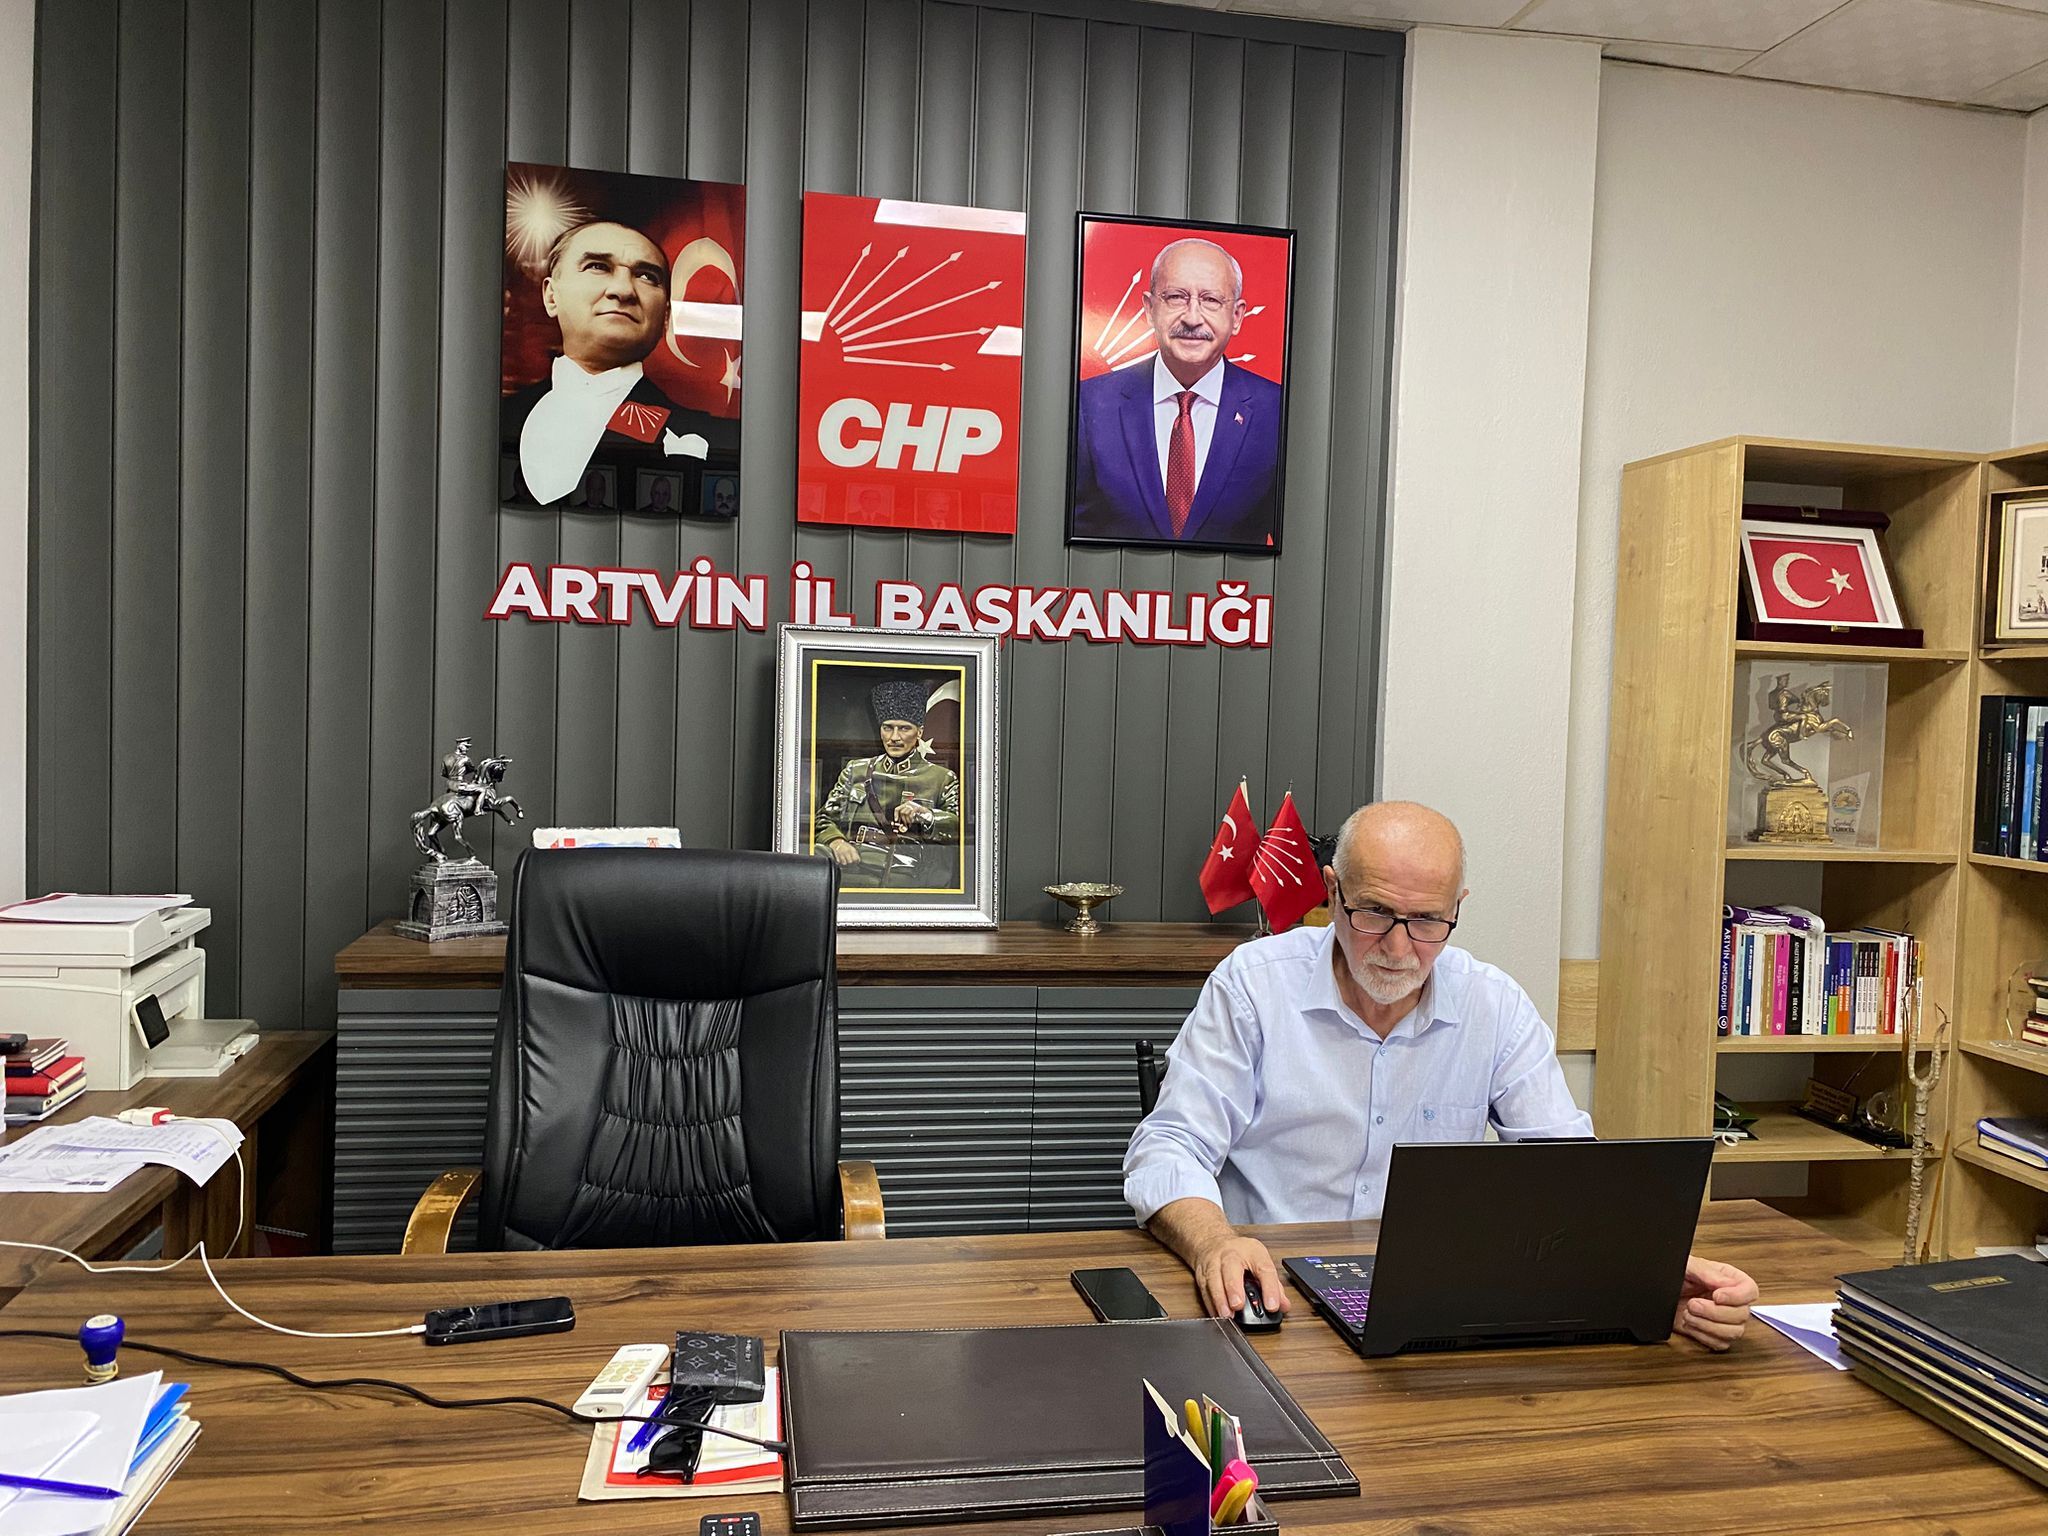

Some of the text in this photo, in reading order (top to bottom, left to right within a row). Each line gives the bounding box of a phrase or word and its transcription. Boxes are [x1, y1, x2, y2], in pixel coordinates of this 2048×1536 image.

[818, 397, 1003, 474] CHP
[483, 555, 768, 631] ARTVİN
[790, 560, 855, 627] İL
[1723, 928, 1731, 960] ARTVİN
